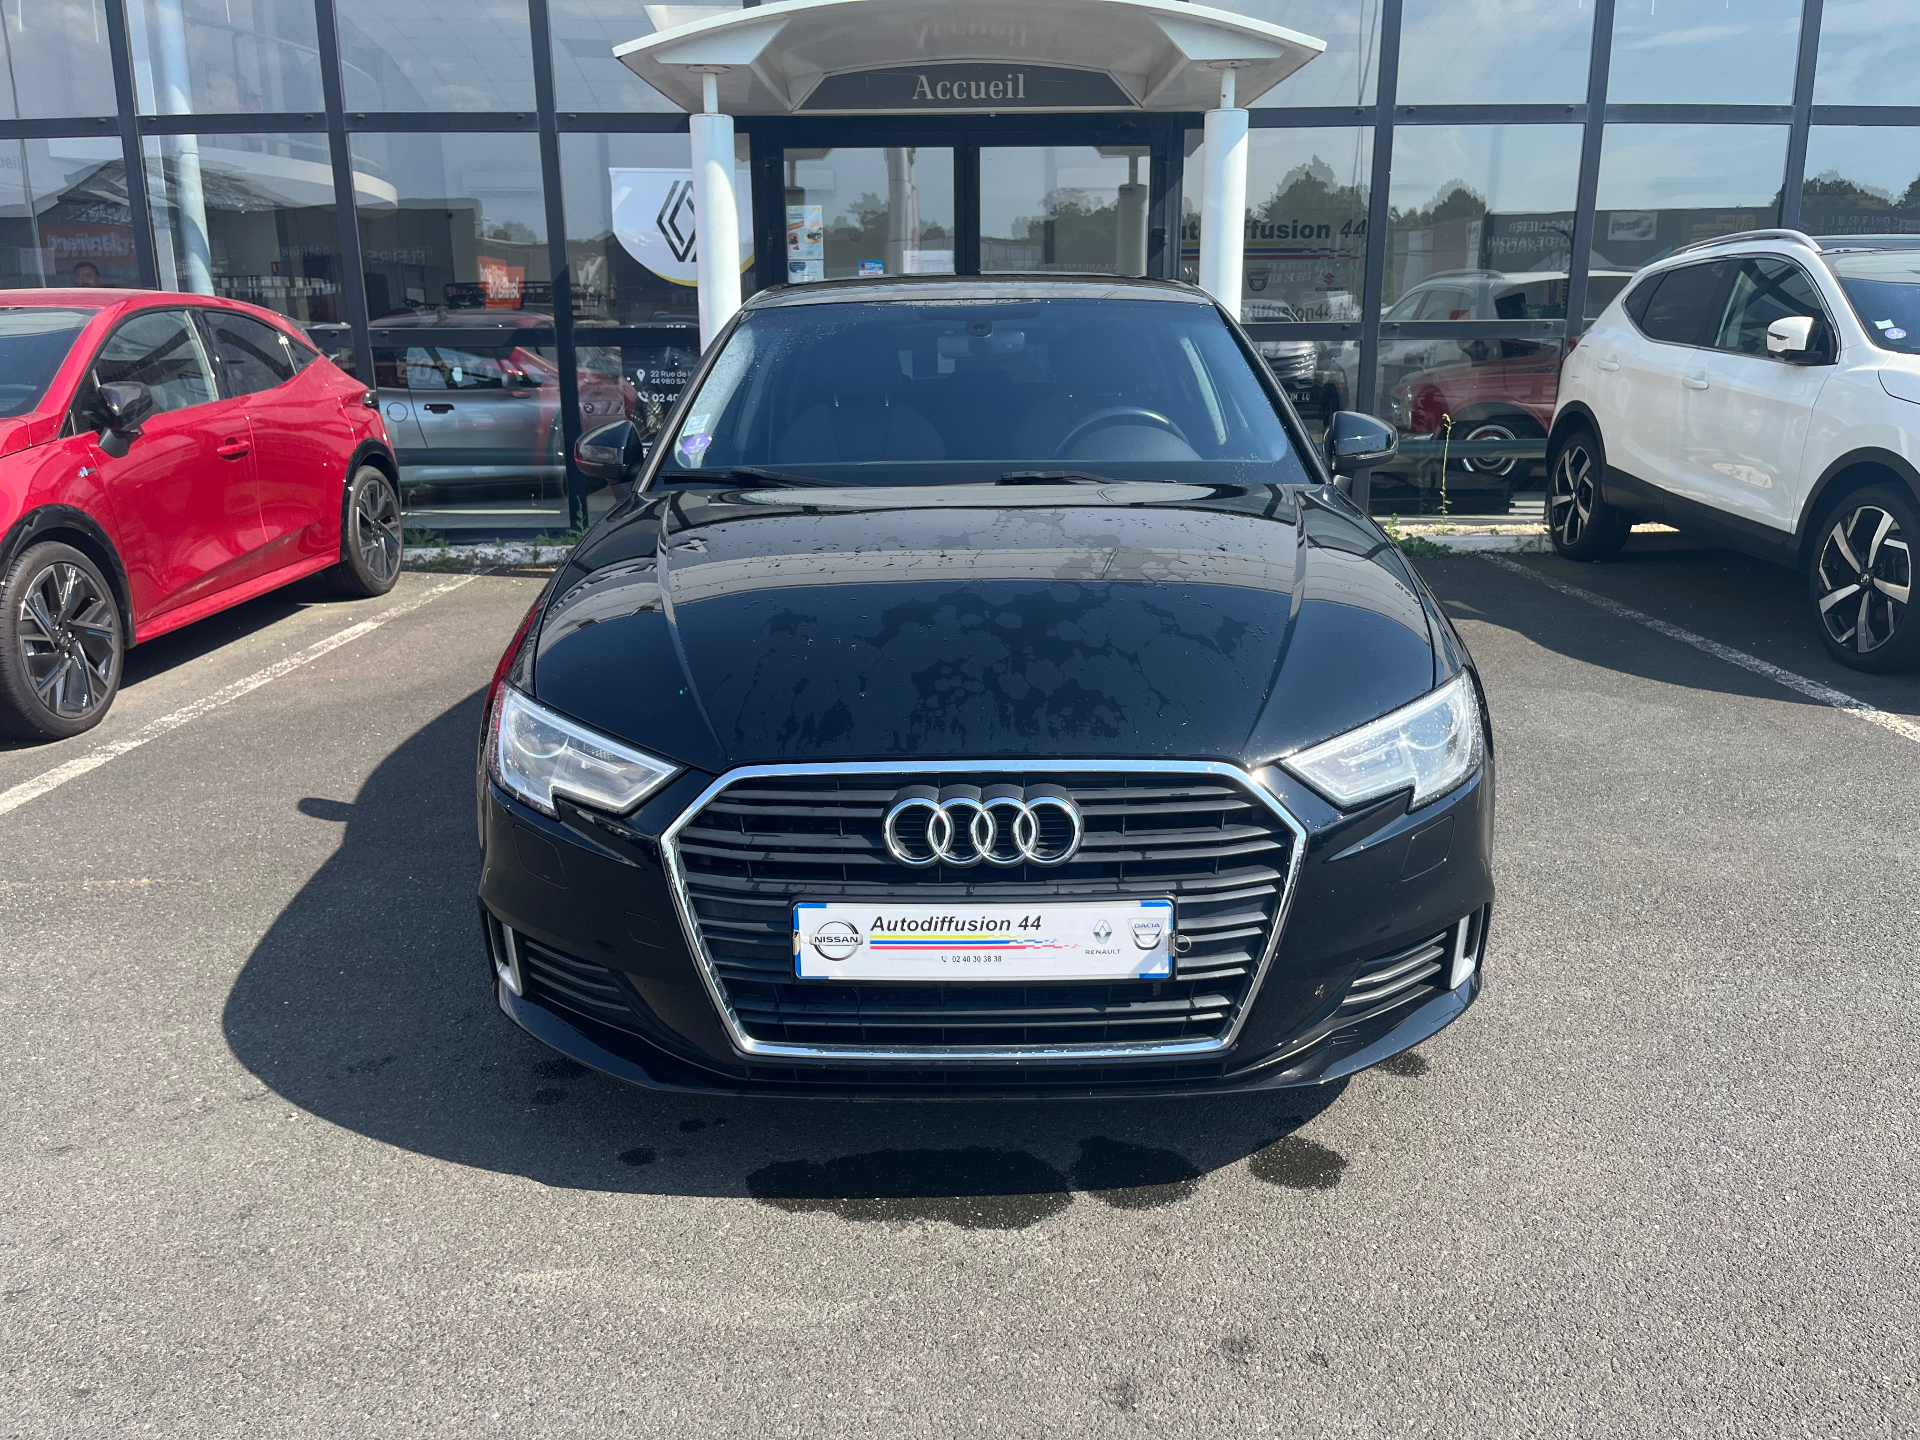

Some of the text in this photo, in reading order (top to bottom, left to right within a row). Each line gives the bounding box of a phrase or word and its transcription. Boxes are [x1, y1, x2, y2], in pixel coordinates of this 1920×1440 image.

[912, 74, 1025, 100] Accueil
[1340, 219, 1367, 239] 44
[652, 394, 666, 402] 02
[870, 915, 1042, 932] Autodiffusion 44
[814, 935, 859, 944] NISSAN
[952, 955, 1002, 964] 02 40 30 38 38
